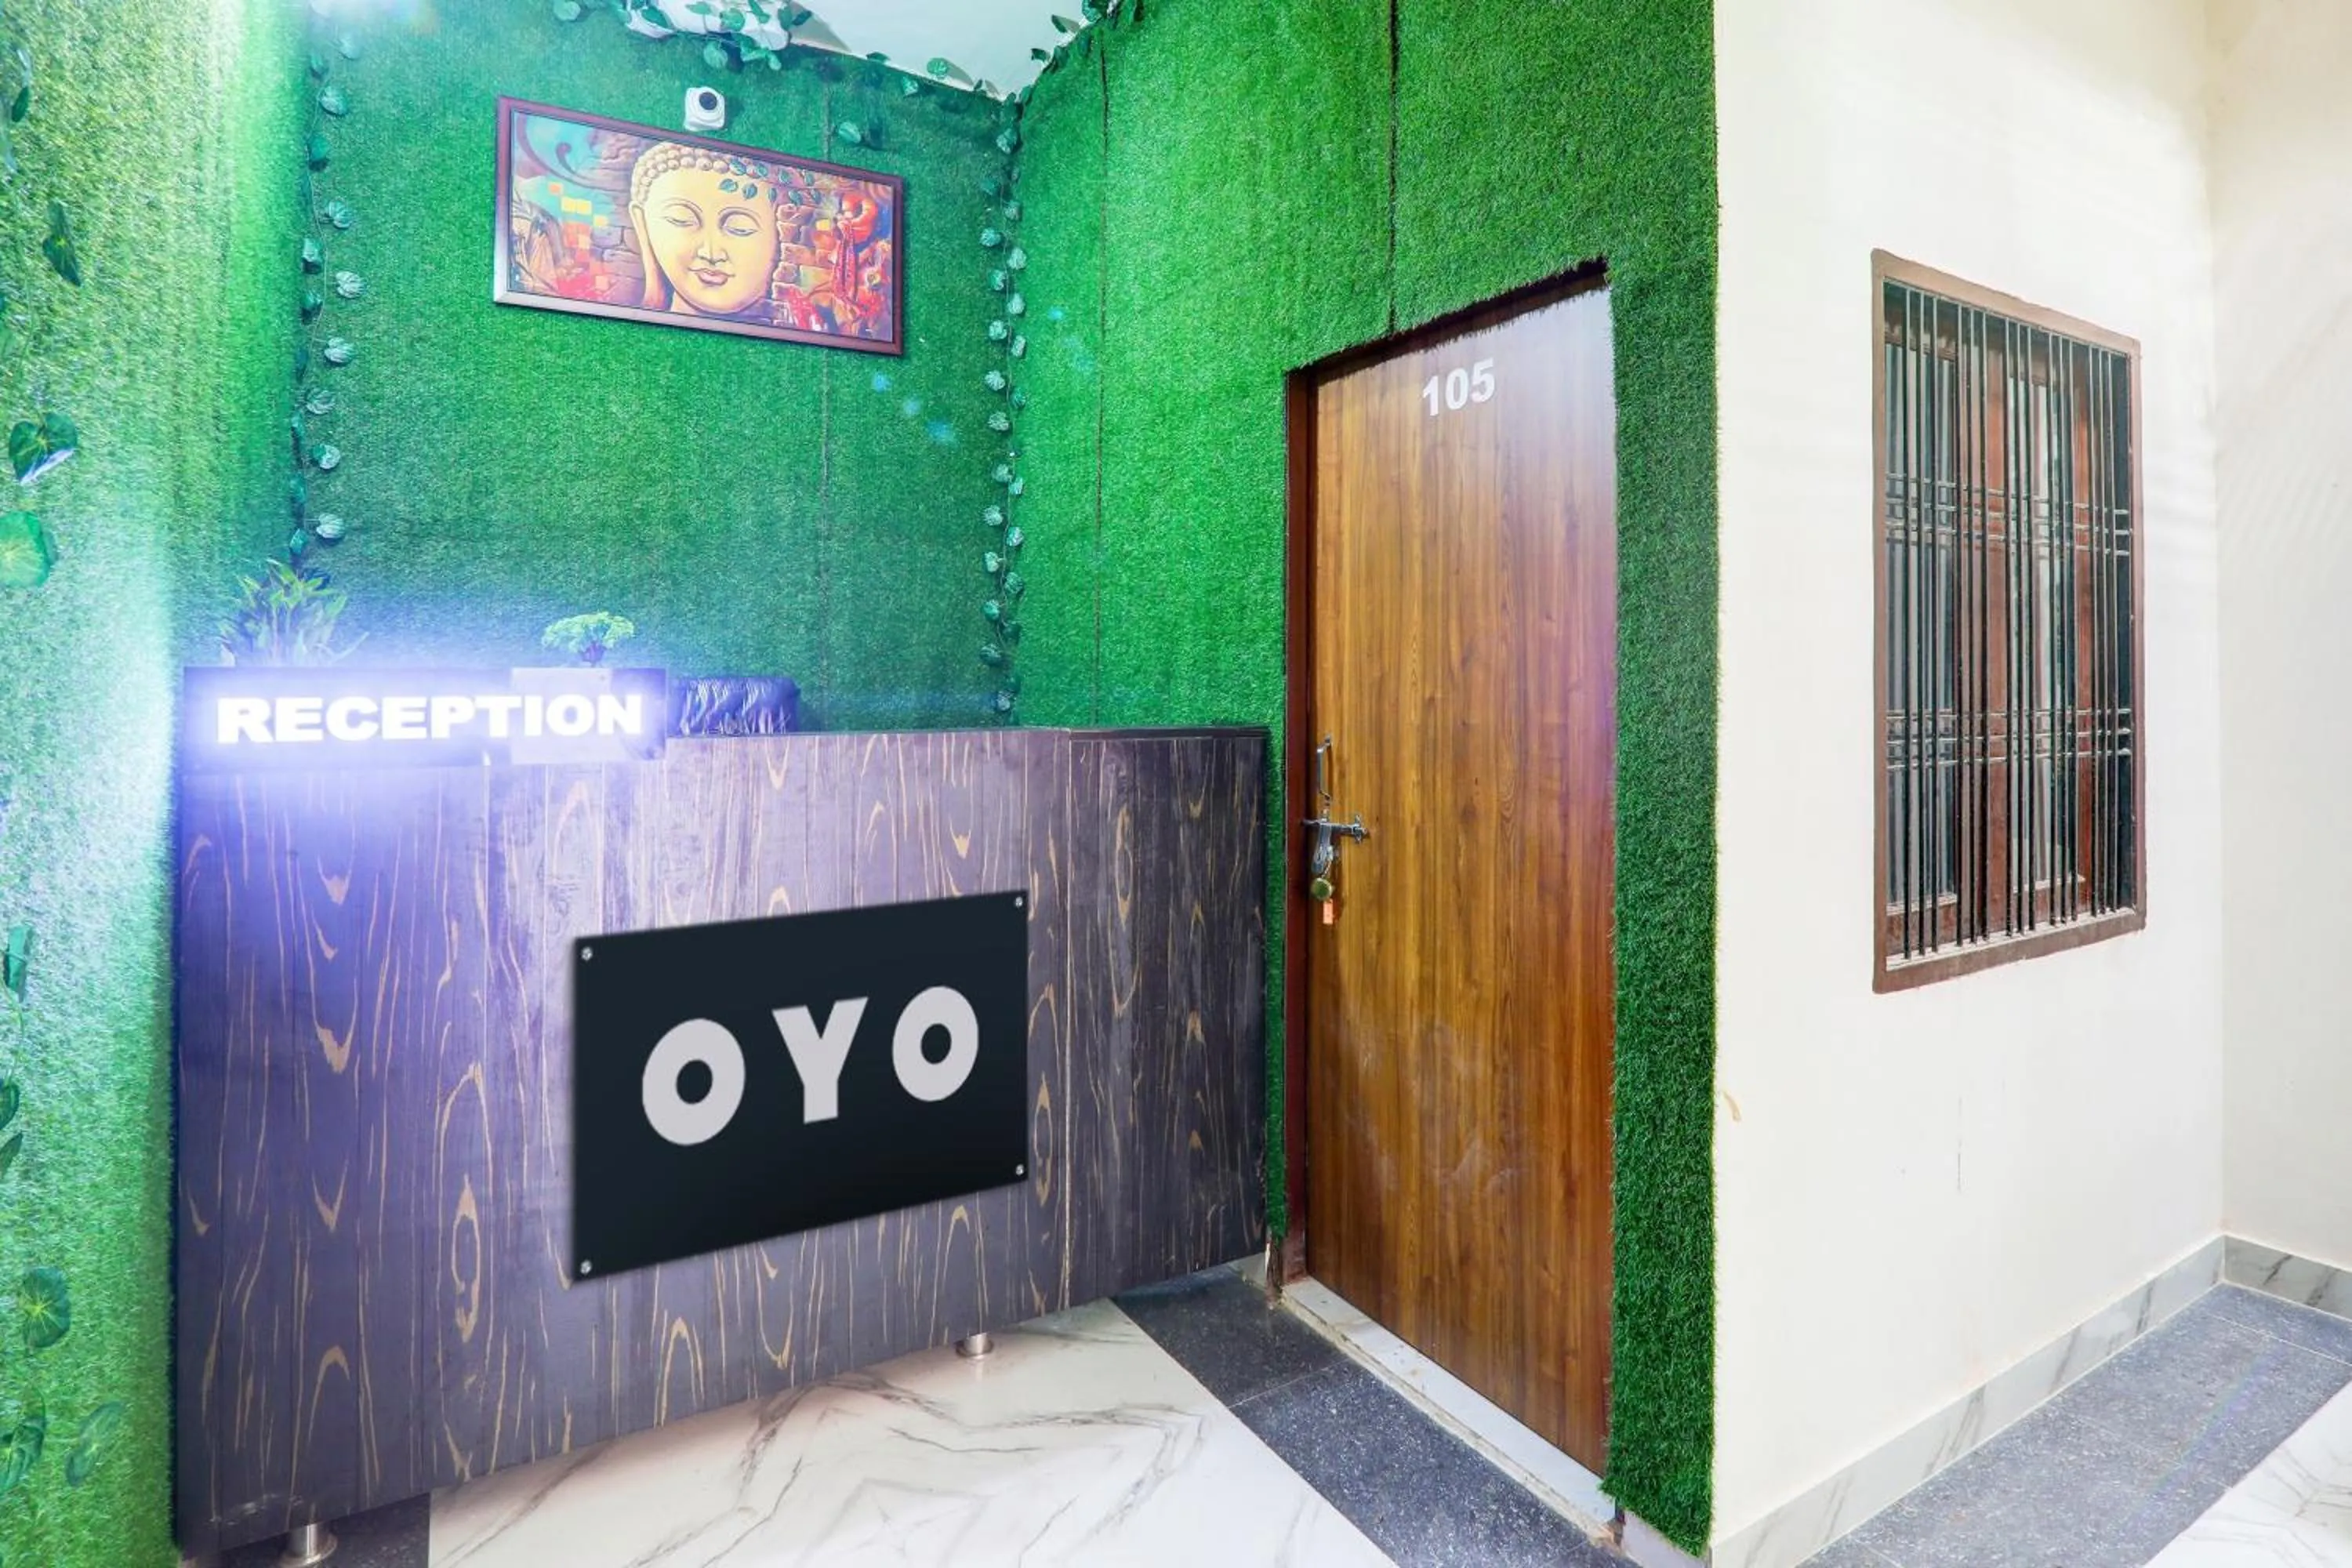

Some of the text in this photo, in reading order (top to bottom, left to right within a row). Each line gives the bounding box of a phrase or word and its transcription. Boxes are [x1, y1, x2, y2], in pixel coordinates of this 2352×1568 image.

[1423, 358, 1495, 416] 105
[216, 695, 642, 743] RECEPTION
[642, 985, 979, 1145] OYO
